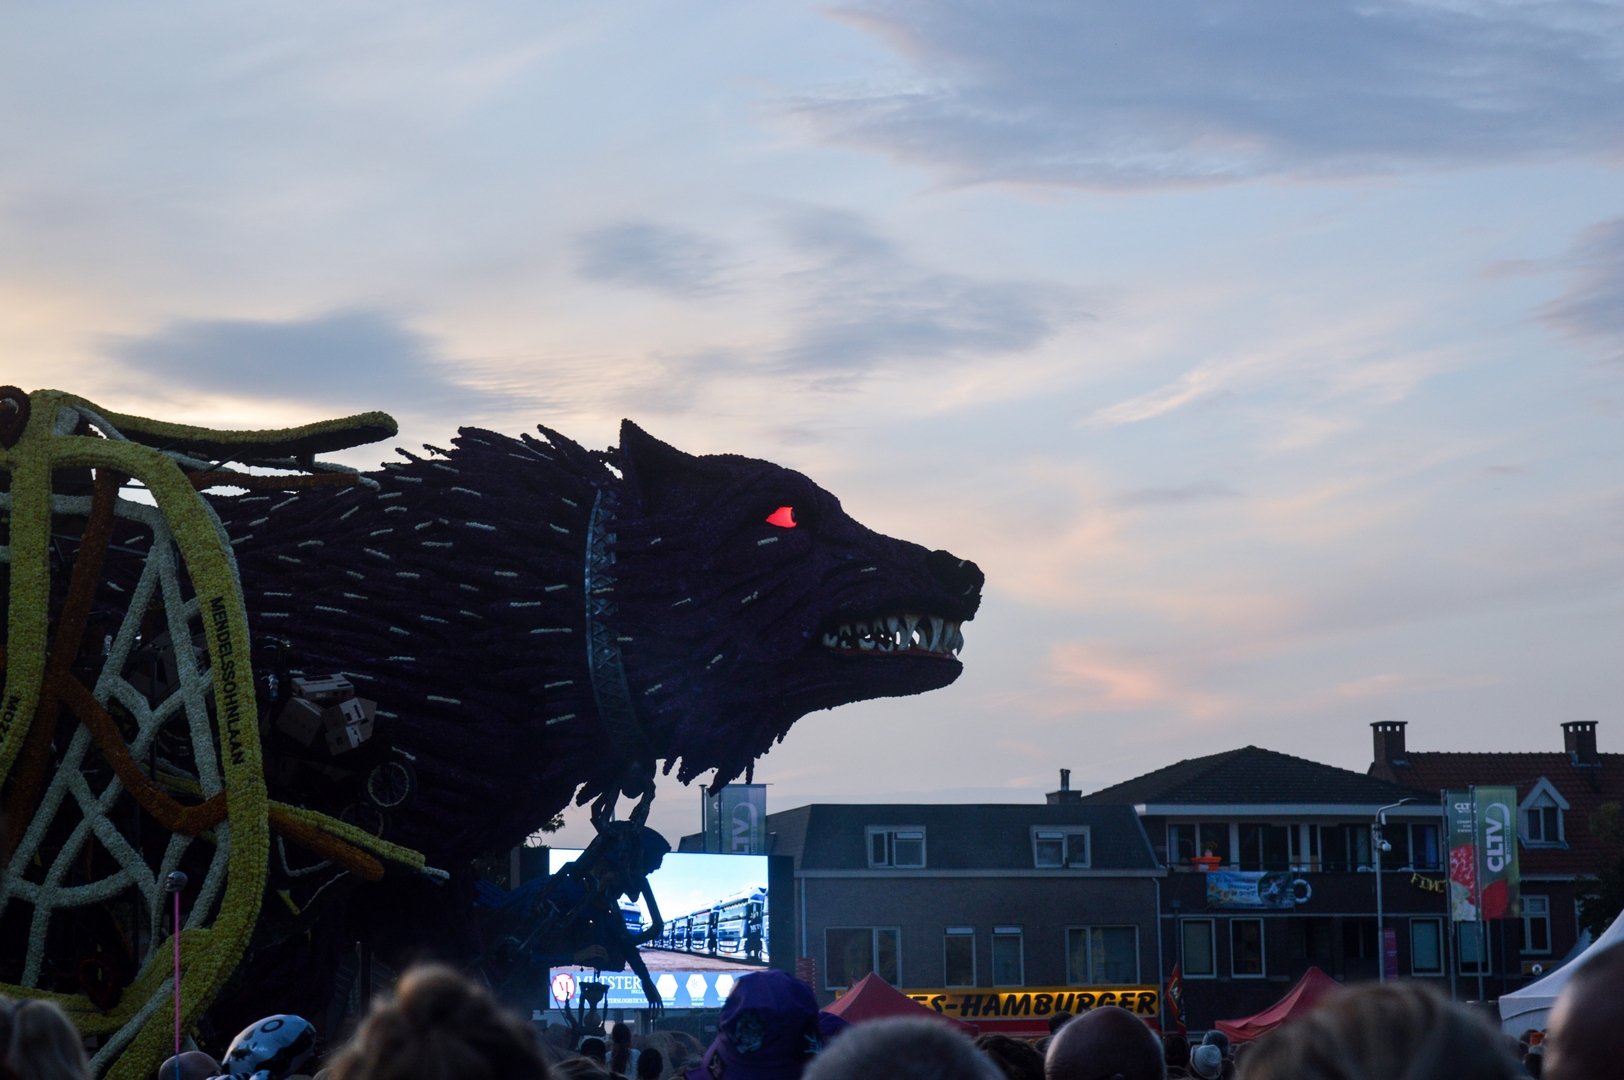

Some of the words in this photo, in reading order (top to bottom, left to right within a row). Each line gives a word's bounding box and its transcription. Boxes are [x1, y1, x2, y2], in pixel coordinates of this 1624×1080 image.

[210, 596, 244, 766] MENDELSSOHNLAAN
[0, 696, 21, 743] MOZ
[1486, 817, 1504, 872] CLTV
